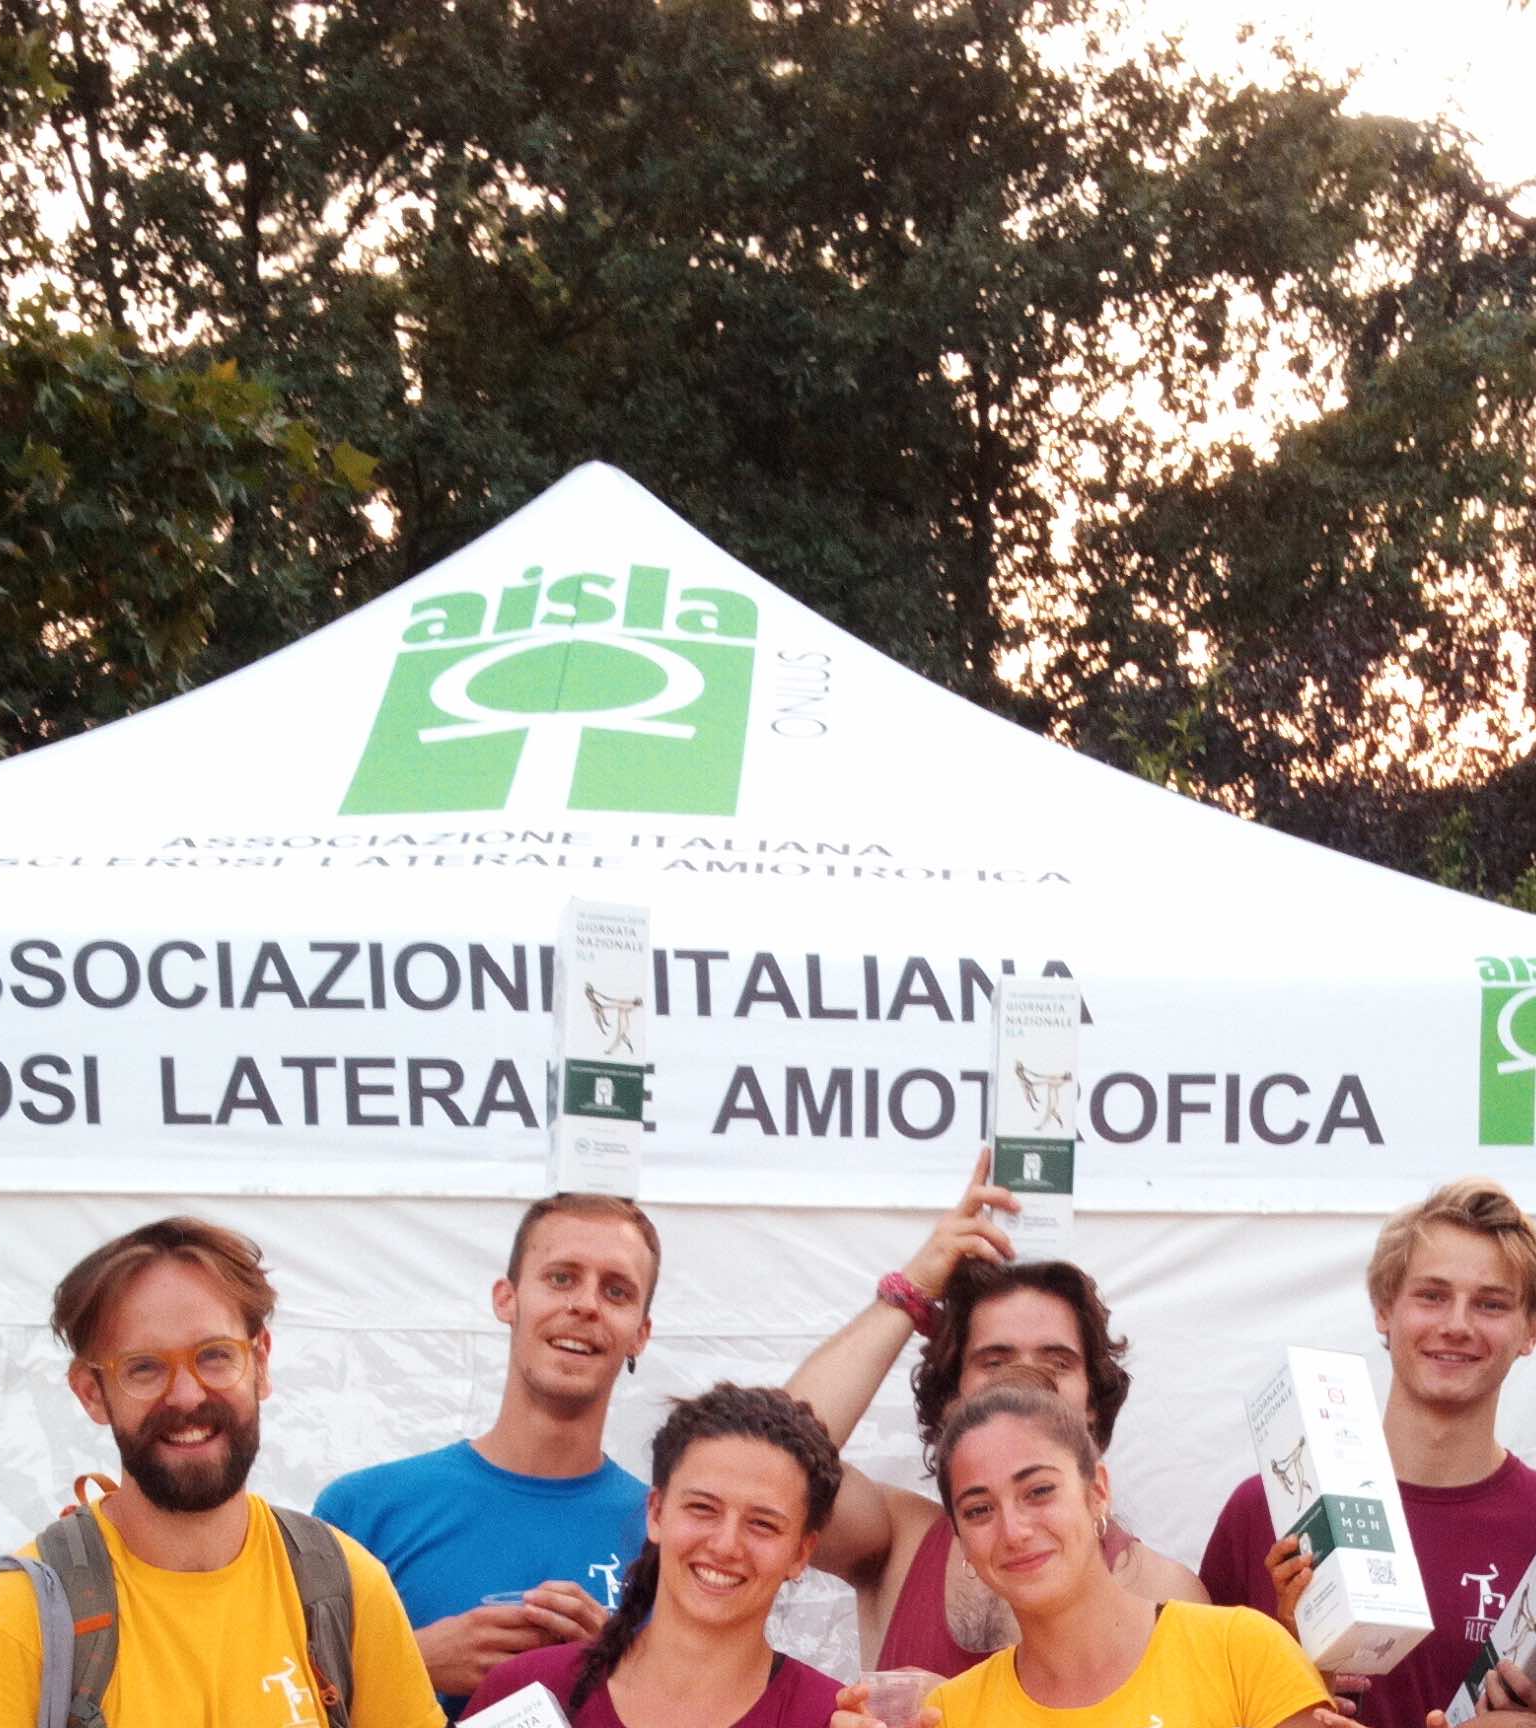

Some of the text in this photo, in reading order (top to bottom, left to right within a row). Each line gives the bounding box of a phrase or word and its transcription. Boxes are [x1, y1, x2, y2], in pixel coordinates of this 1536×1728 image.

[402, 564, 758, 643] aisla
[163, 827, 893, 857] ASSOCIAZIONE ITALIANA
[160, 1054, 656, 1133] LATERA
[711, 1064, 1385, 1148] AMIOTOFICA
[1342, 1518, 1380, 1531] MON
[1464, 1620, 1488, 1644] FLIC
